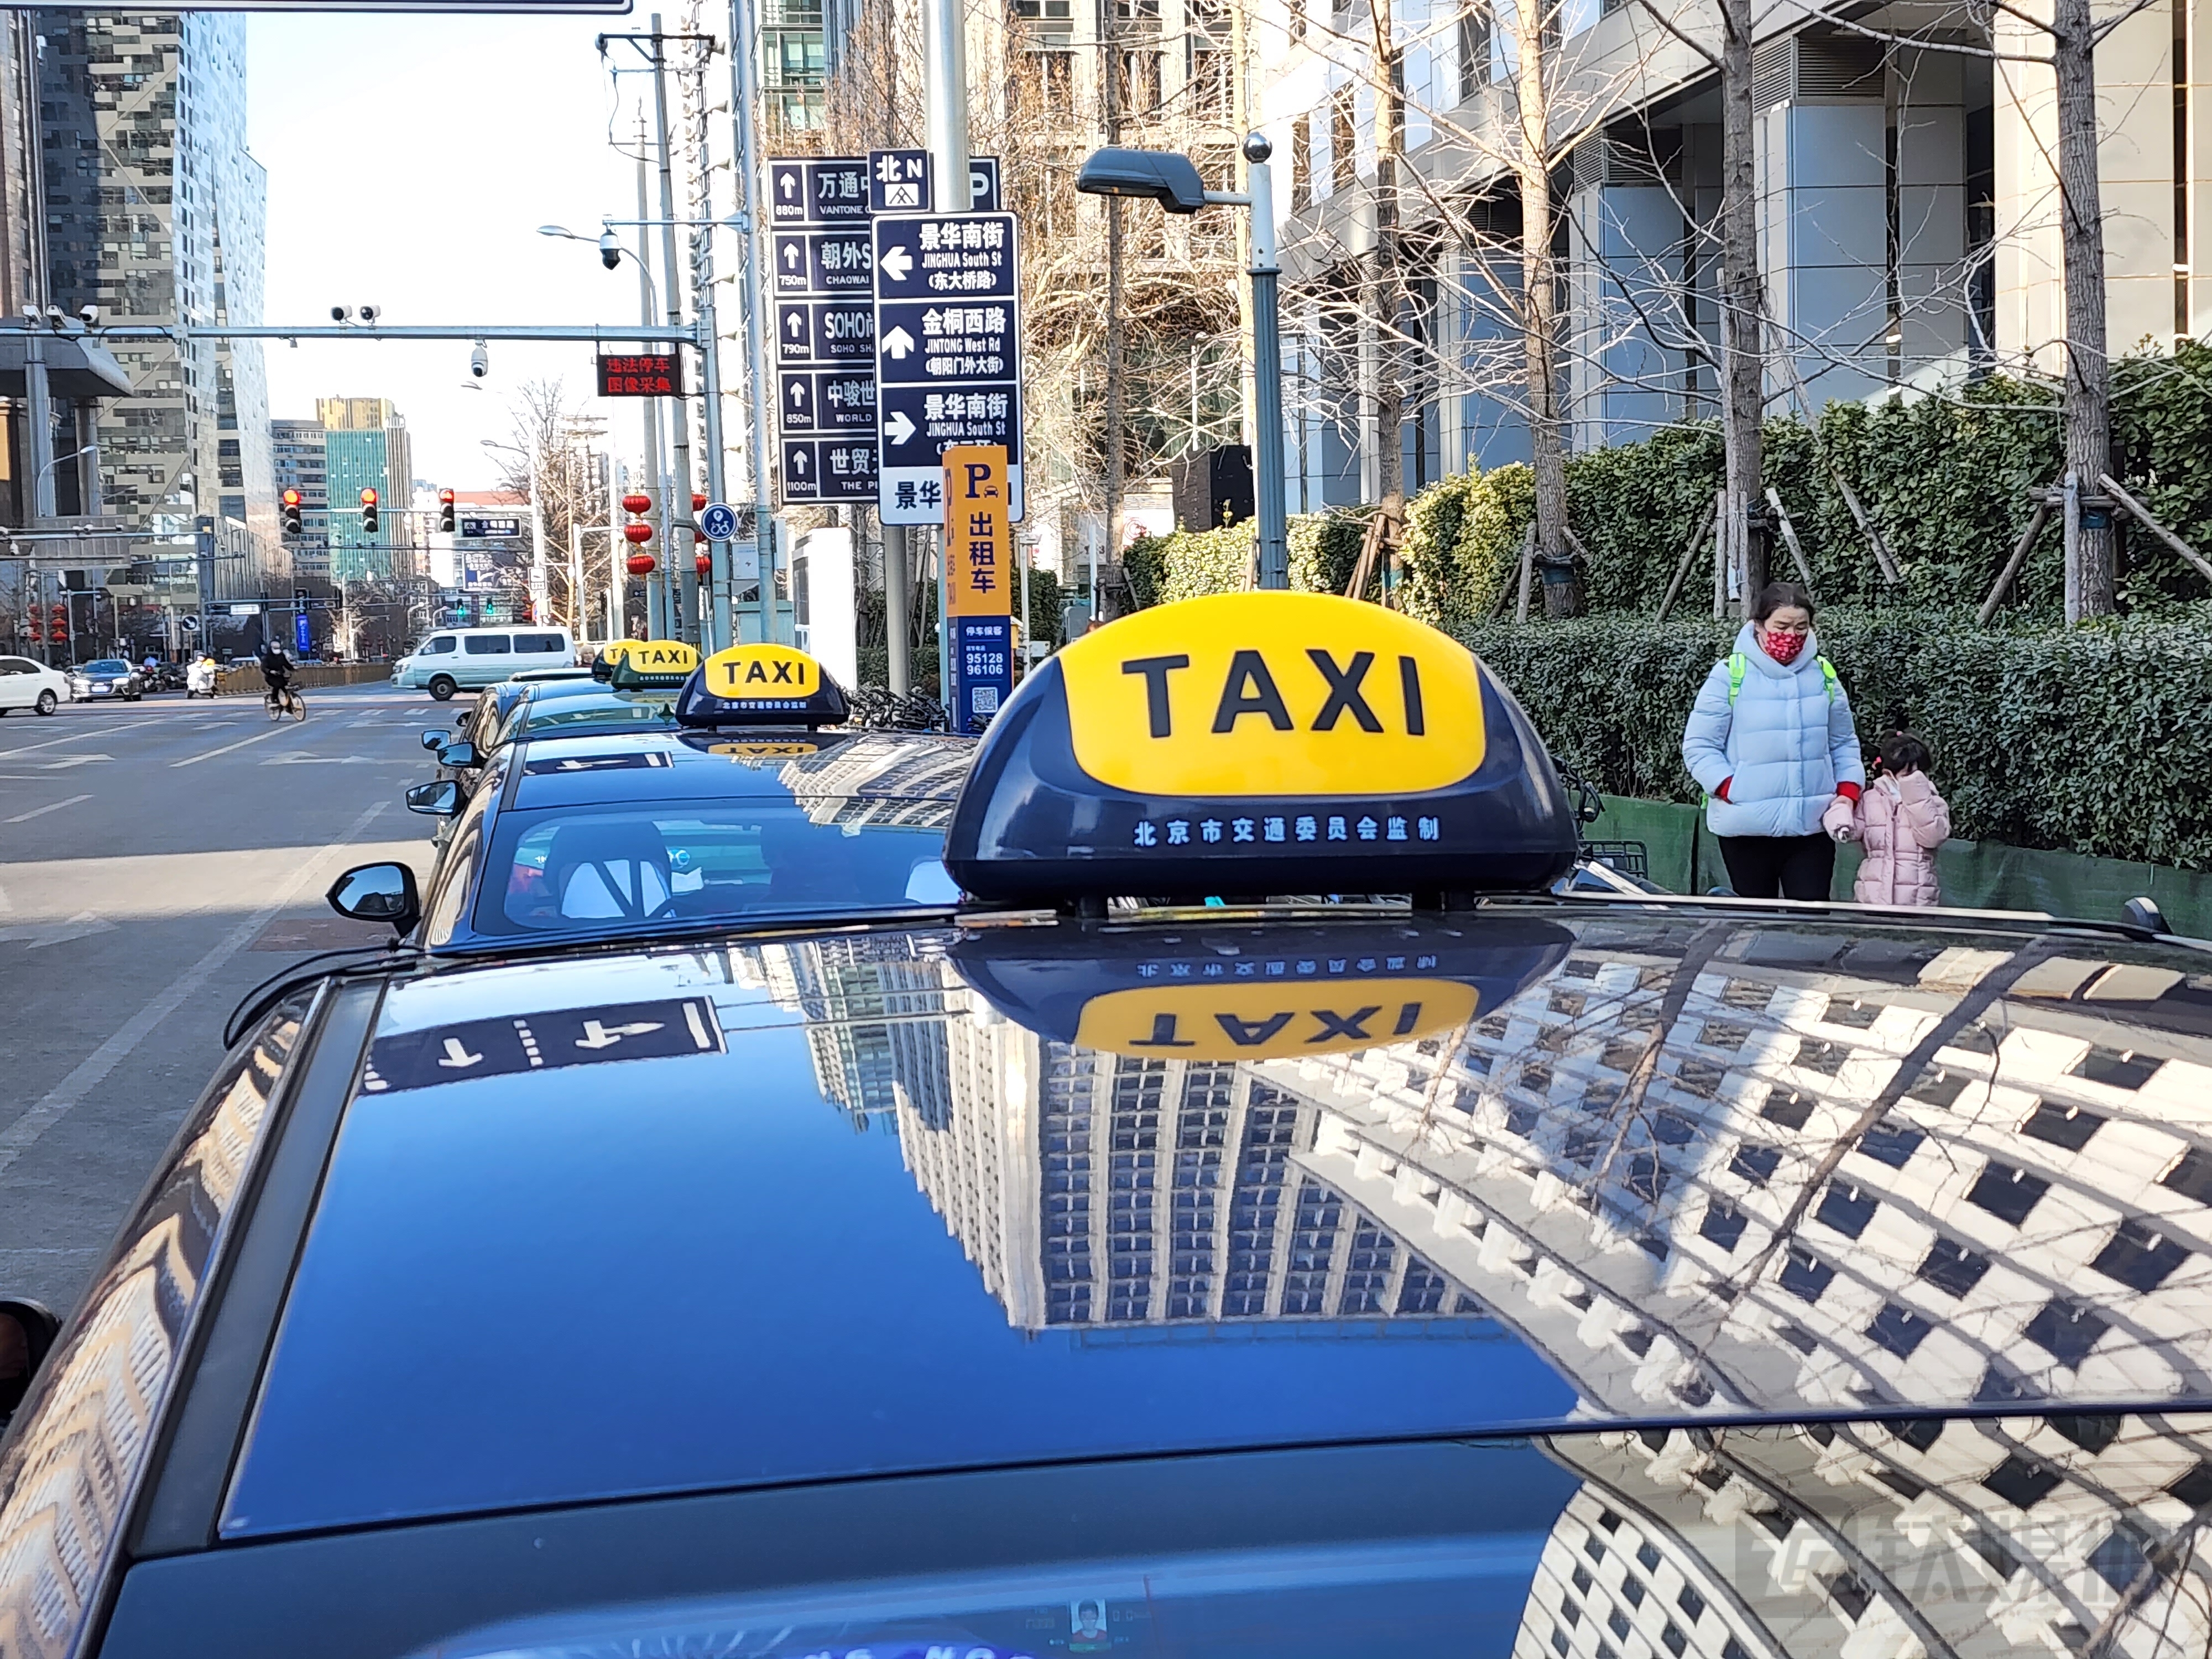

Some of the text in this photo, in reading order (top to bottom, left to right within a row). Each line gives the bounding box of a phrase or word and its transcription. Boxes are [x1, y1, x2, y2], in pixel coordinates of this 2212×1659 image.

[875, 155, 922, 182] 北 N
[969, 172, 989, 210] P
[775, 205, 803, 216] 880m
[819, 205, 864, 215] VANTONE
[919, 221, 1005, 251] 景华南街
[921, 251, 1003, 268] JINGHUA South St
[779, 275, 807, 286] 750m
[826, 275, 870, 285] CHAOWAI
[928, 270, 997, 291] (东大桥路)
[921, 306, 1006, 335] 金桐西路
[830, 343, 874, 353] SOHO SH
[925, 337, 1001, 354] JINTONG West Rd
[606, 357, 670, 373] 违法停车
[925, 355, 1004, 376] (朝阳门外大街)
[827, 379, 876, 408] 中骏世
[924, 393, 1008, 421] 景华南街
[786, 414, 811, 424] 850m
[836, 413, 872, 422] WORLD
[926, 420, 1005, 437] JINGHUA South St
[829, 447, 878, 475] 世贸
[787, 482, 817, 492] 1100m
[841, 481, 862, 491] THE
[963, 463, 991, 498] P
[968, 511, 996, 594] 出租车
[638, 649, 688, 664] TAXI
[966, 653, 1004, 664] 95128
[722, 660, 805, 685] TAXI
[966, 664, 1004, 675] 96106
[1121, 649, 1425, 738] TAXI
[1134, 816, 1439, 847] 北京市交通委员会监制
